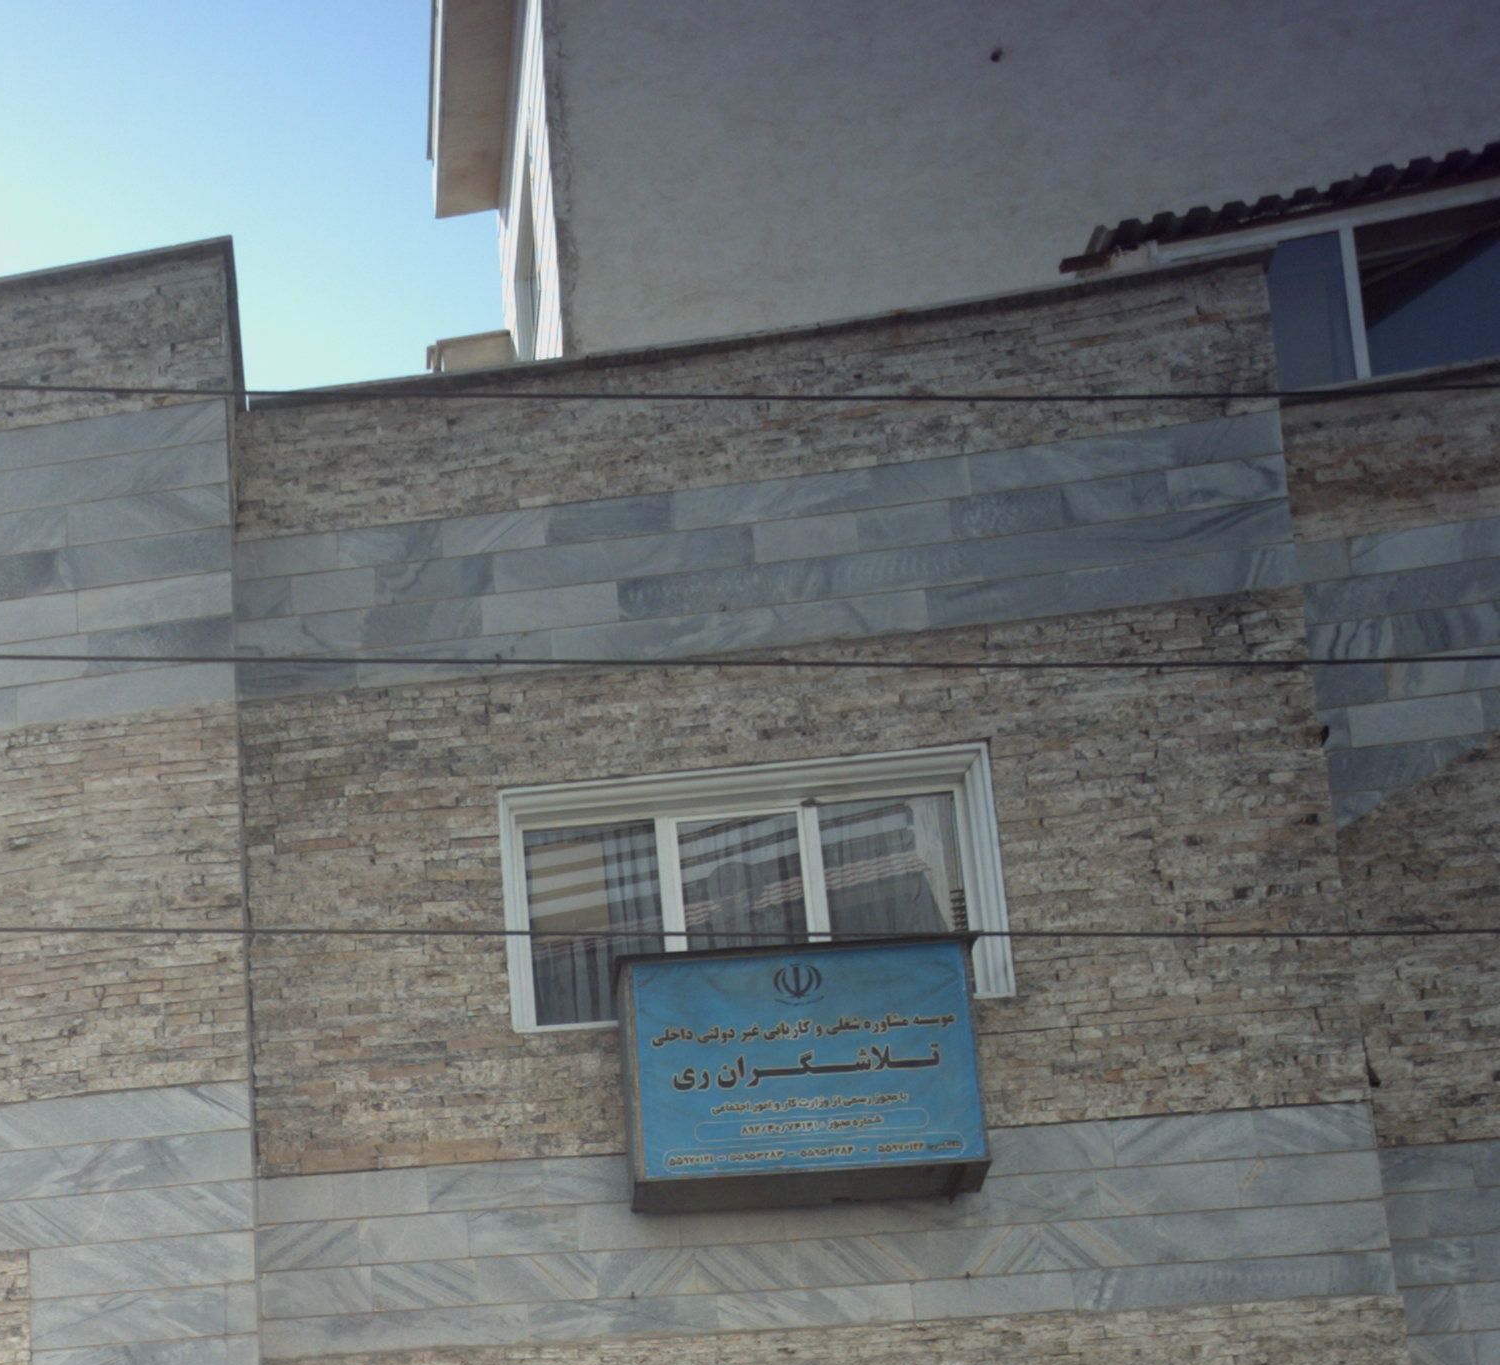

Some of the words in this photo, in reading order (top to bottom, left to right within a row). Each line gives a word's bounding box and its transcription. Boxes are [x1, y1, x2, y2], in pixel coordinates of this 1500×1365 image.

[826, 1017, 860, 1035] شغلی
[863, 1013, 908, 1033] مشاوره
[652, 1026, 694, 1047] داخلی
[697, 1026, 736, 1044] دولتی
[717, 1043, 941, 1088] تلاشگران
[673, 1067, 710, 1090] ری
